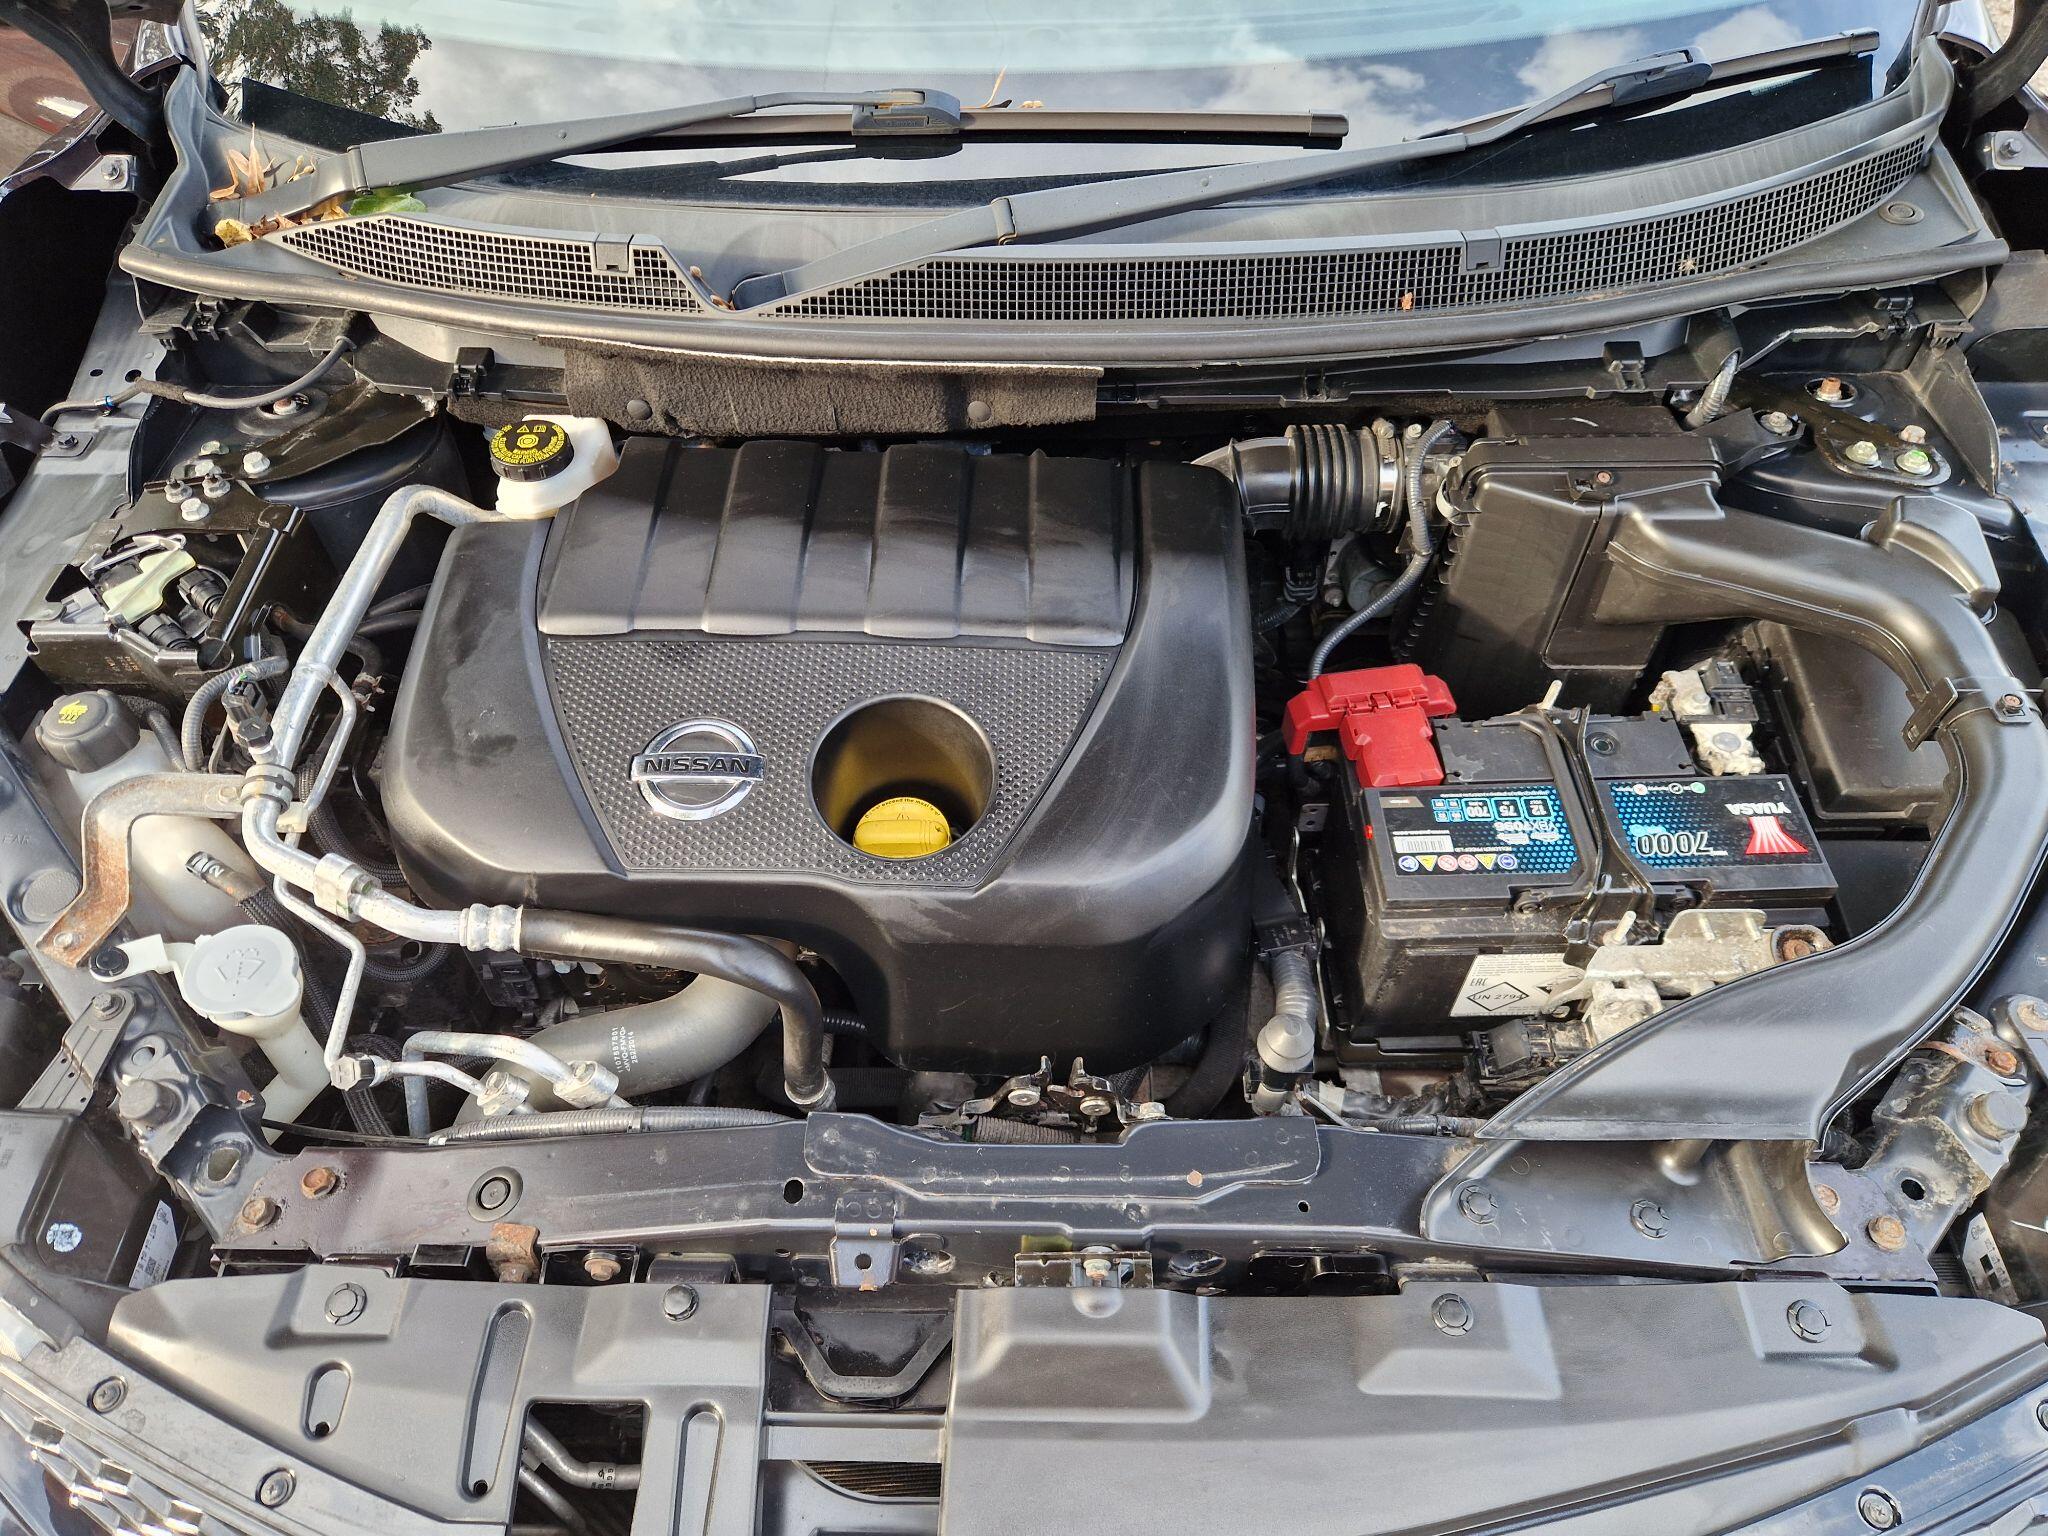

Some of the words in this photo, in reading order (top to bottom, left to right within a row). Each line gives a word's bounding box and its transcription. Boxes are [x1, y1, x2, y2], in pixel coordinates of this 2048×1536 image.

[643, 757, 751, 774] NISSAN
[1466, 806, 1490, 818] 700
[1500, 805, 1518, 817] 75
[1530, 804, 1547, 816] 12
[1725, 801, 1792, 815] YUASA
[1635, 831, 1714, 857] 7000
